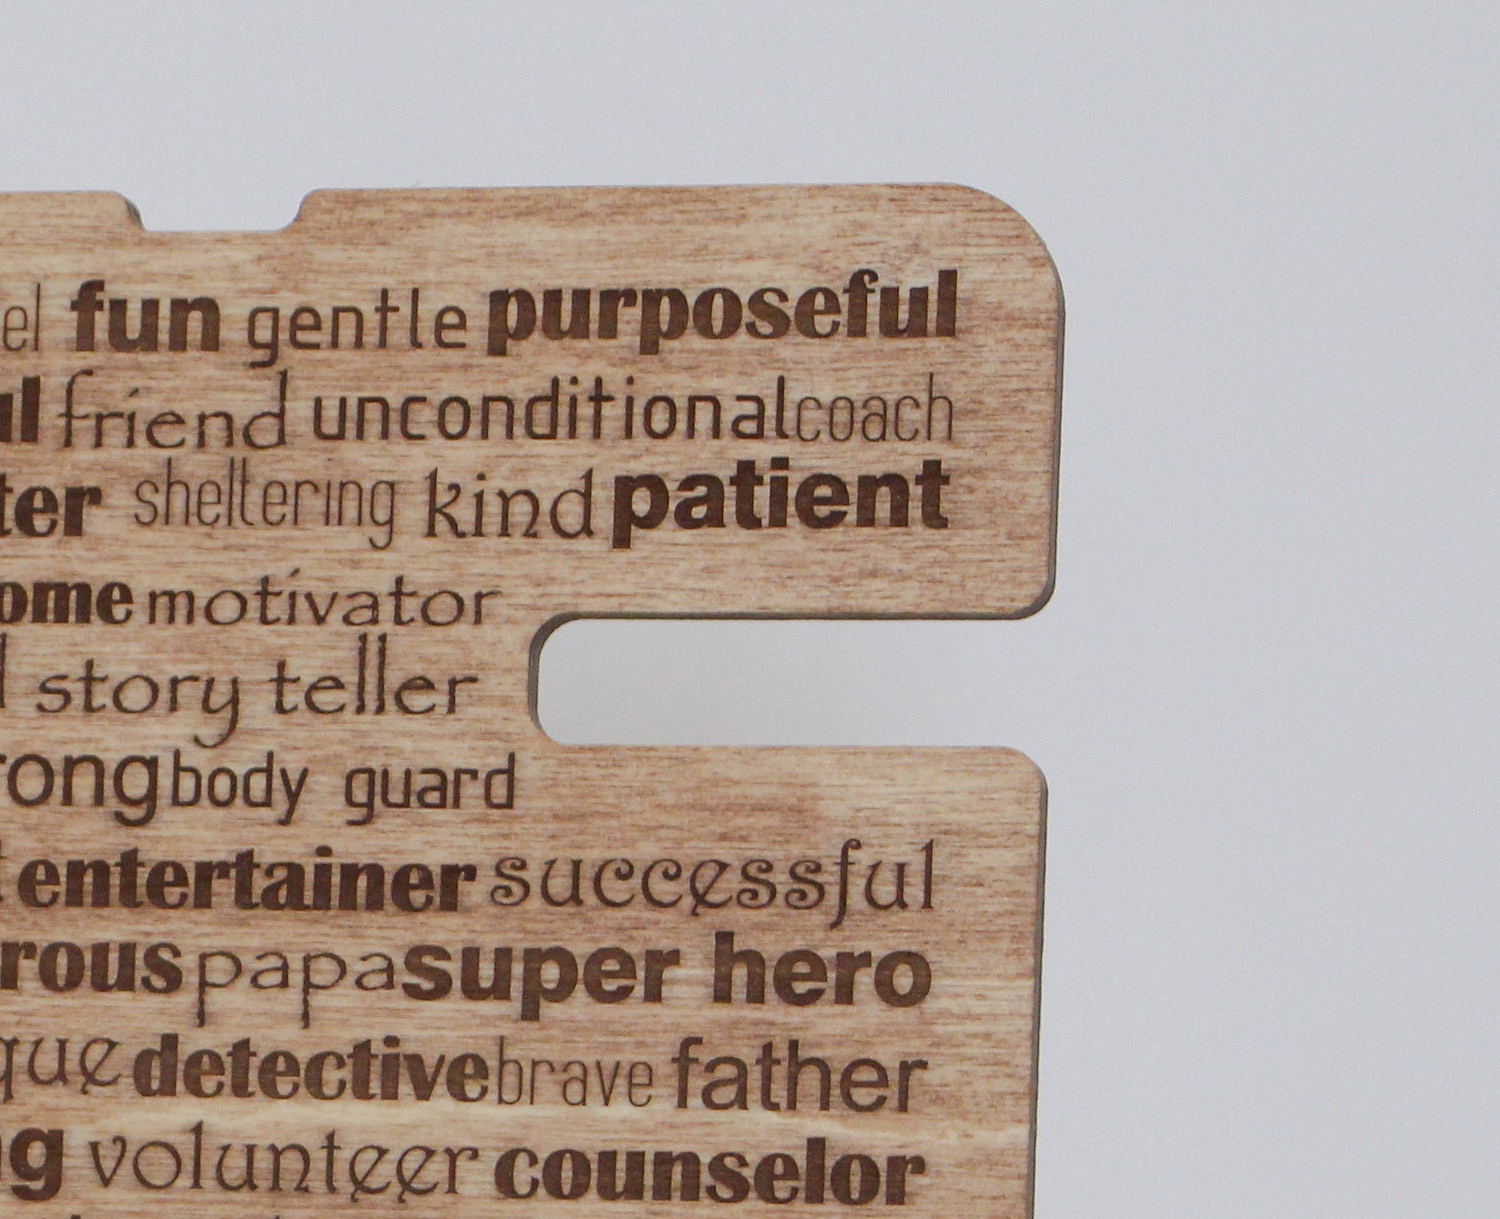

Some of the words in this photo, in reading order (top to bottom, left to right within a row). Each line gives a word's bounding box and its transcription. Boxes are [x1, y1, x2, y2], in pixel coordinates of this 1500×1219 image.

[70, 280, 220, 353] fun
[248, 287, 469, 368] gentle
[487, 268, 958, 356] purposeful
[58, 369, 288, 450] friend
[312, 374, 791, 442] unconditional
[798, 373, 953, 442] coach
[133, 457, 395, 549] sheltering
[425, 467, 595, 540] kind
[612, 456, 949, 548] patient
[147, 568, 502, 626] motivator
[35, 658, 239, 748] story
[270, 632, 478, 716] teller
[172, 750, 308, 825] body
[345, 751, 516, 826] guard
[17, 845, 476, 911] entertainer
[490, 838, 935, 930] successful
[196, 950, 396, 1029] papa
[402, 941, 680, 1022] super
[714, 931, 932, 1007] hero
[133, 1033, 490, 1103] detective
[497, 1035, 654, 1108] brave
[671, 1036, 929, 1114] father
[87, 1121, 479, 1204] volunteer
[495, 1137, 926, 1206] counselor
